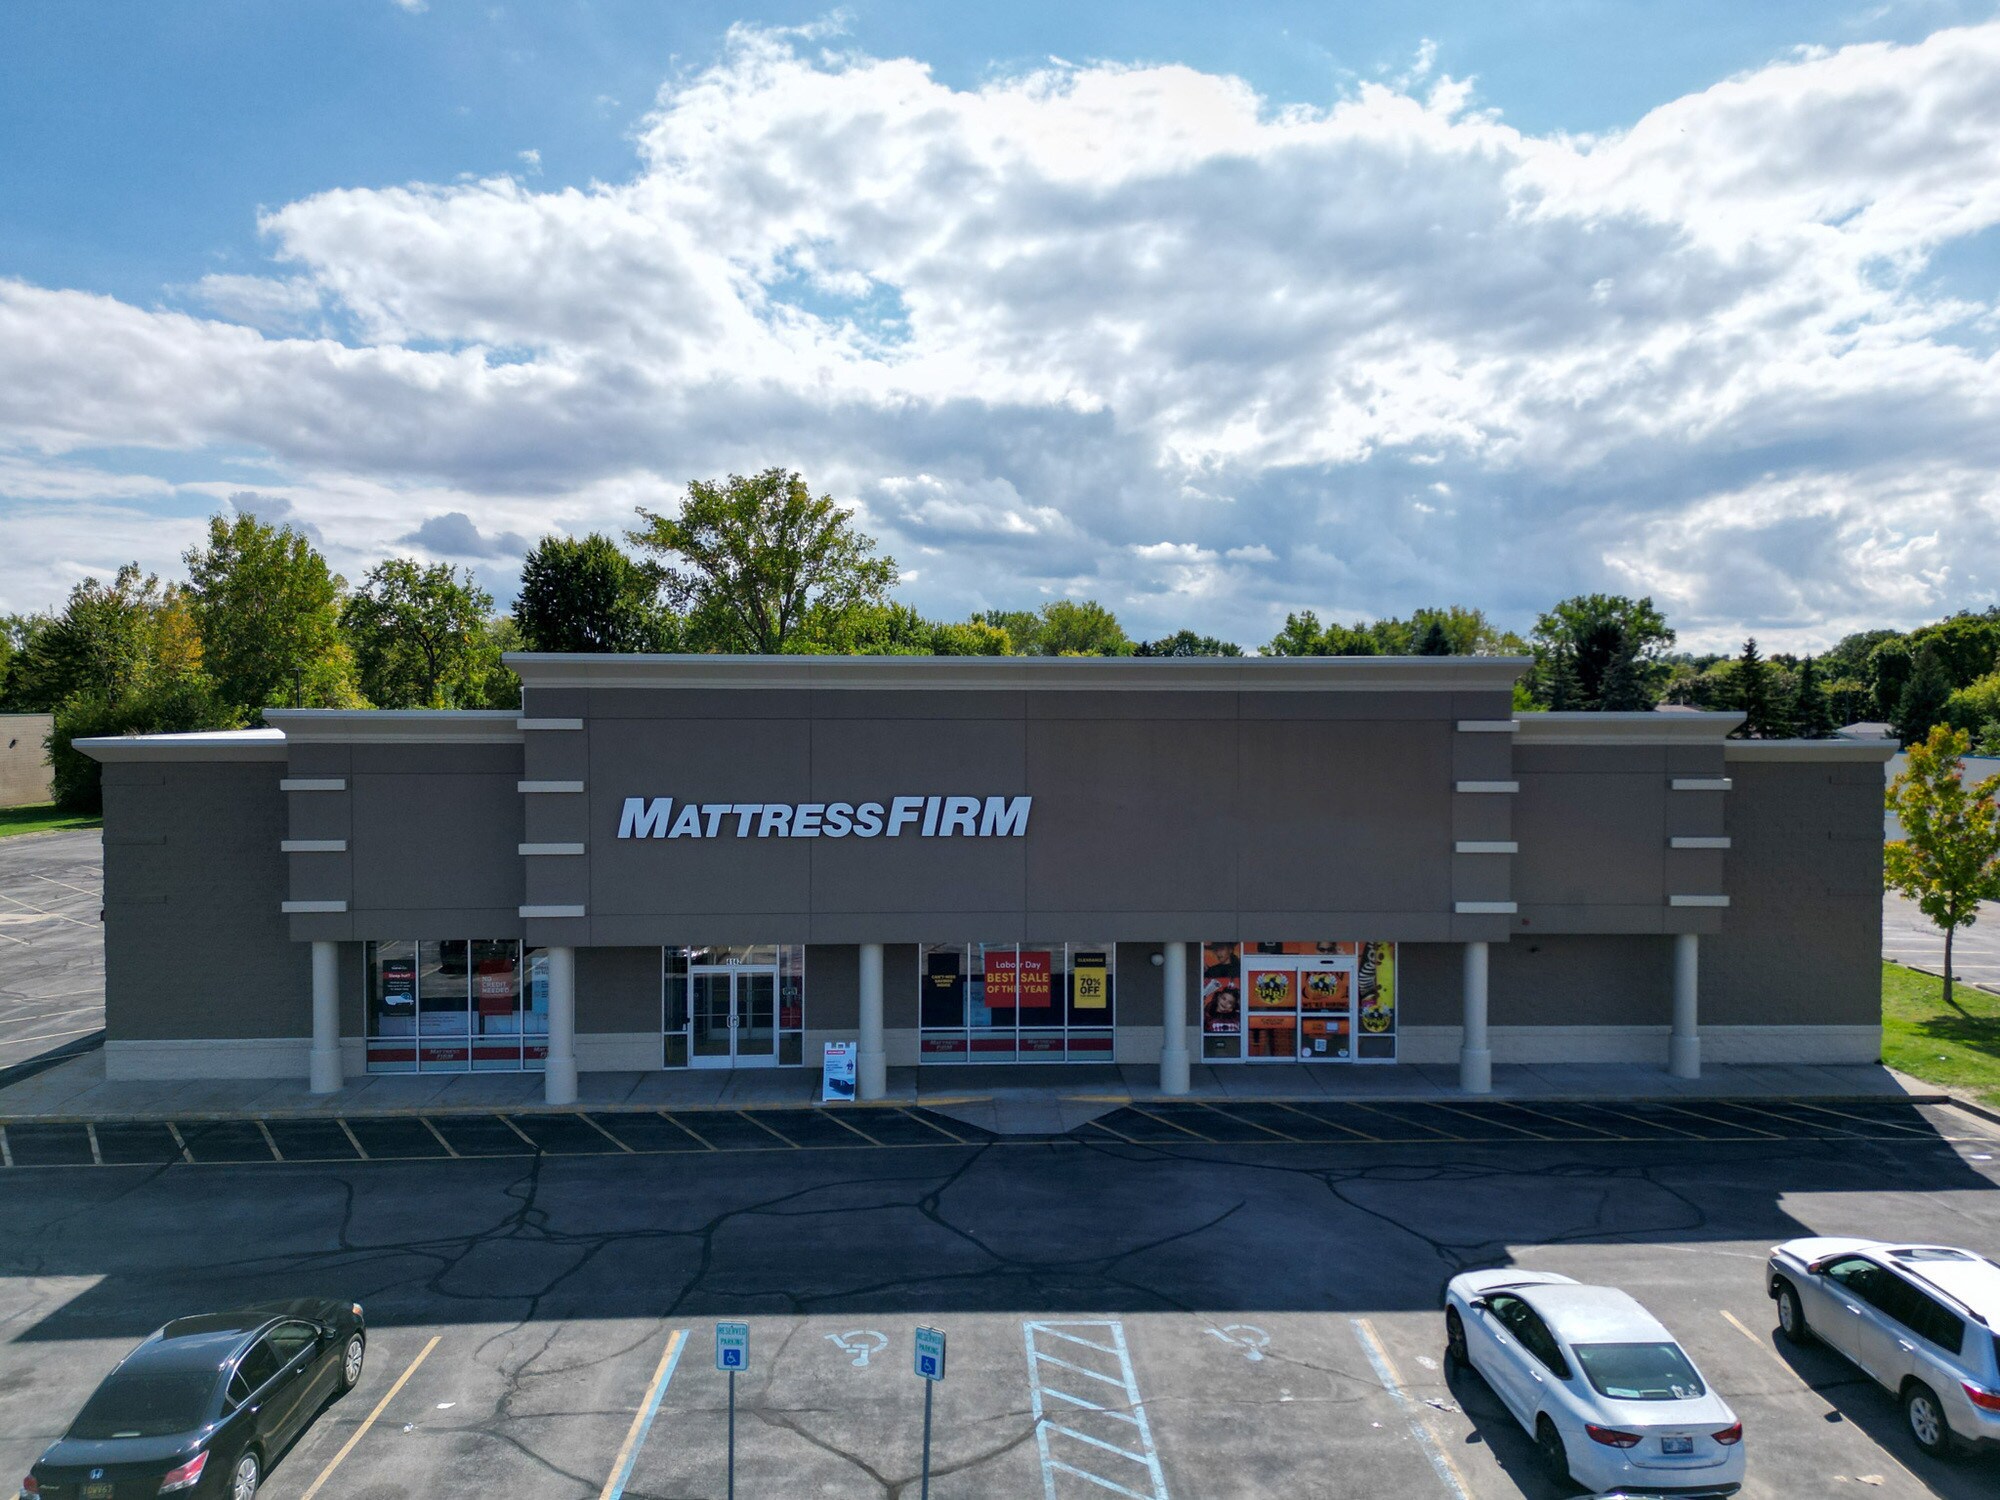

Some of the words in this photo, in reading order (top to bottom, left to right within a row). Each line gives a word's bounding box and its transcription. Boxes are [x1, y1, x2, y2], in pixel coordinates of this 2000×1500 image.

[1025, 961, 1041, 970] Day
[987, 973, 1015, 982] BEST
[1020, 973, 1049, 982] SALE
[1080, 978, 1101, 986] 70%
[987, 985, 1000, 993] OF
[1024, 985, 1049, 993] YEAR
[1080, 986, 1100, 994] OFF
[719, 1326, 746, 1335] RESERVED
[720, 1337, 744, 1347] PARKING
[917, 1331, 941, 1344] RESERVED
[919, 1342, 939, 1355] PARKING
